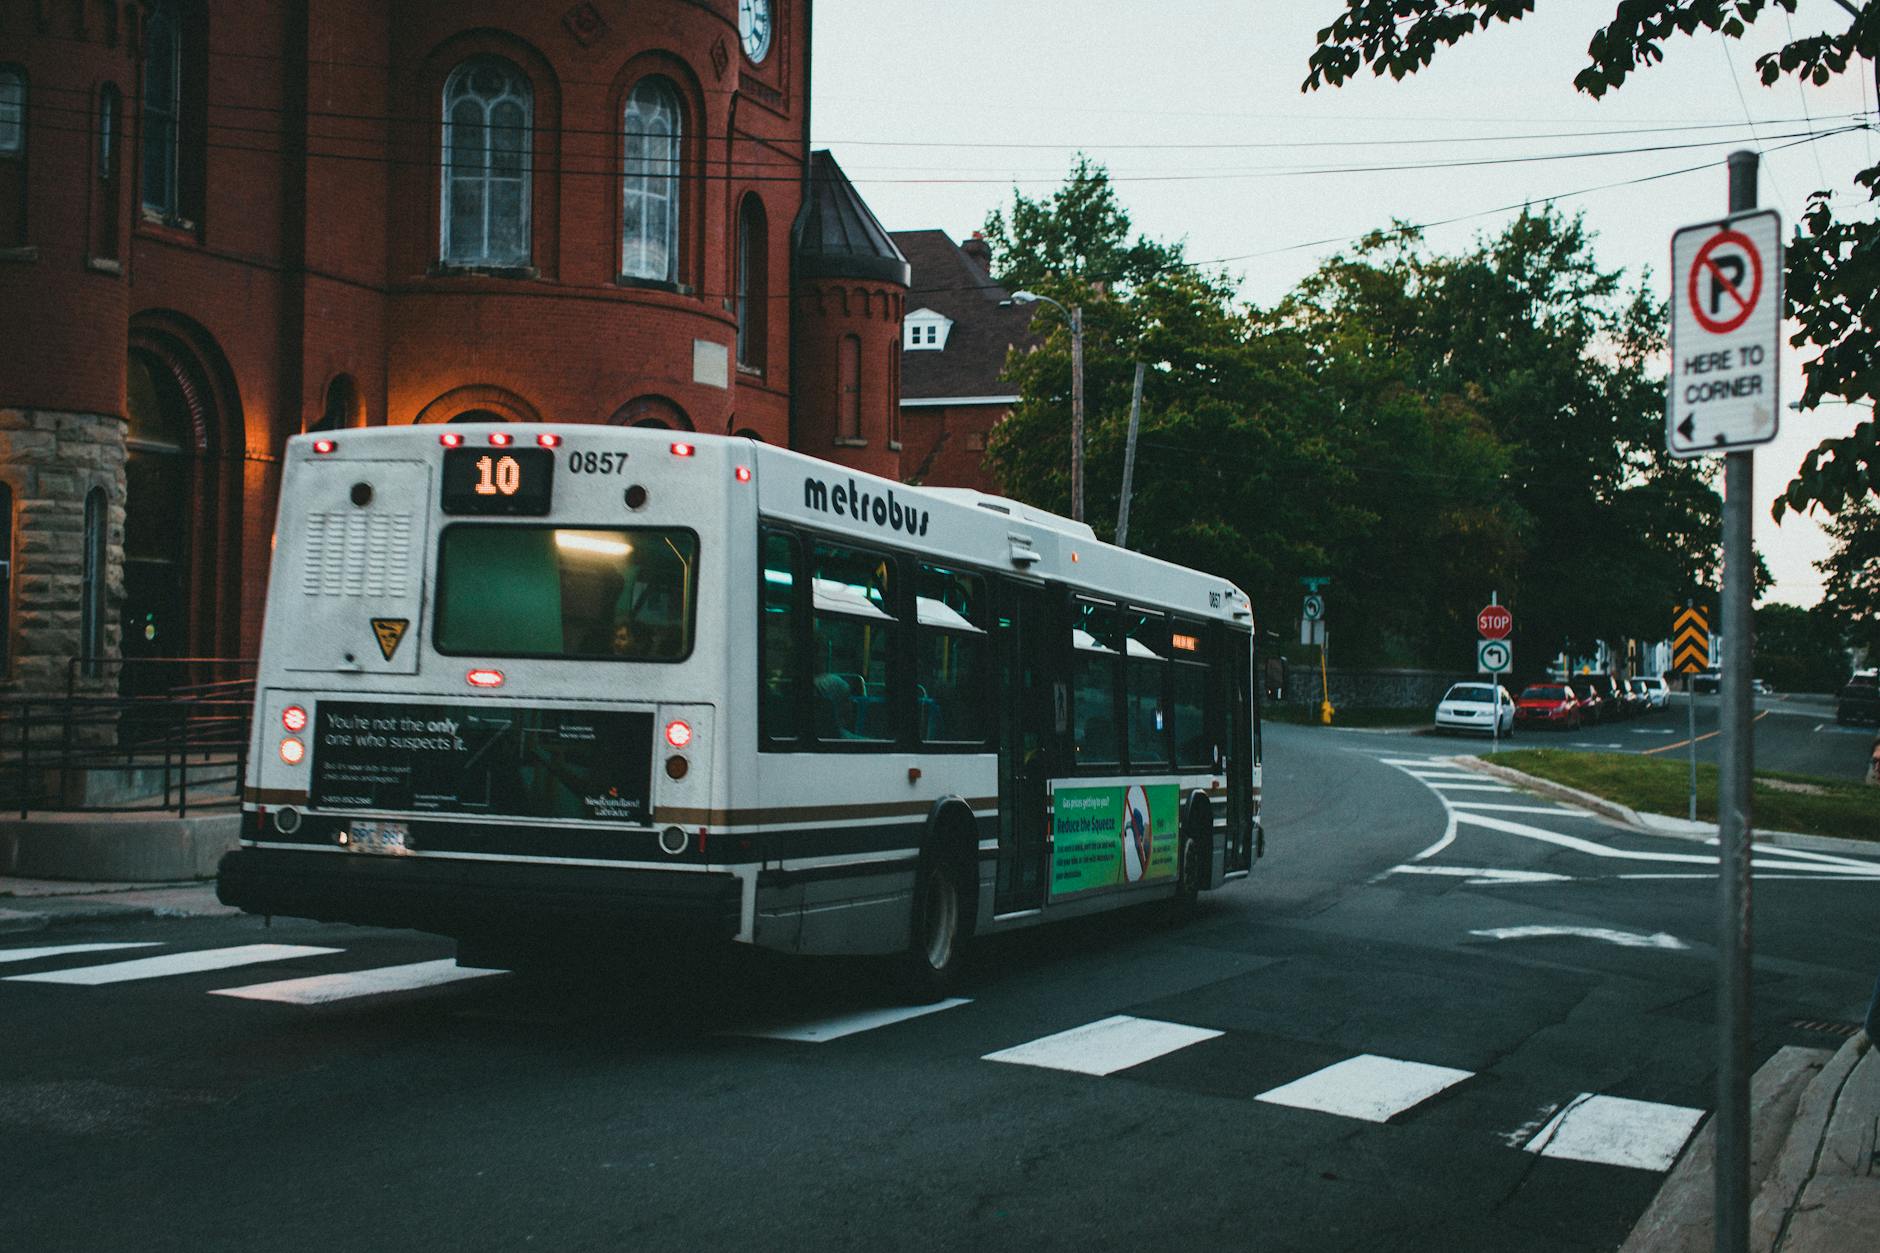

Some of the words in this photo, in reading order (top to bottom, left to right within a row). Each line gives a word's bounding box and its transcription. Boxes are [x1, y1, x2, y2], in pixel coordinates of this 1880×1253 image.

[1684, 349, 1732, 376] HERE
[1739, 345, 1765, 367] TO
[1684, 375, 1763, 405] CORNER
[568, 450, 629, 475] 0857
[475, 455, 520, 495] 10
[804, 476, 929, 537] metrobus
[1208, 591, 1221, 609] 0857
[1480, 616, 1509, 629] STOP
[326, 713, 370, 730] You're
[373, 716, 398, 731] not
[400, 716, 425, 732] the
[427, 718, 460, 736] only
[324, 733, 352, 746] one
[354, 732, 388, 748] who
[389, 736, 451, 751] suspects
[1057, 817, 1079, 833] Reduce
[1080, 816, 1090, 832] the
[1091, 816, 1115, 835] Squeeze
